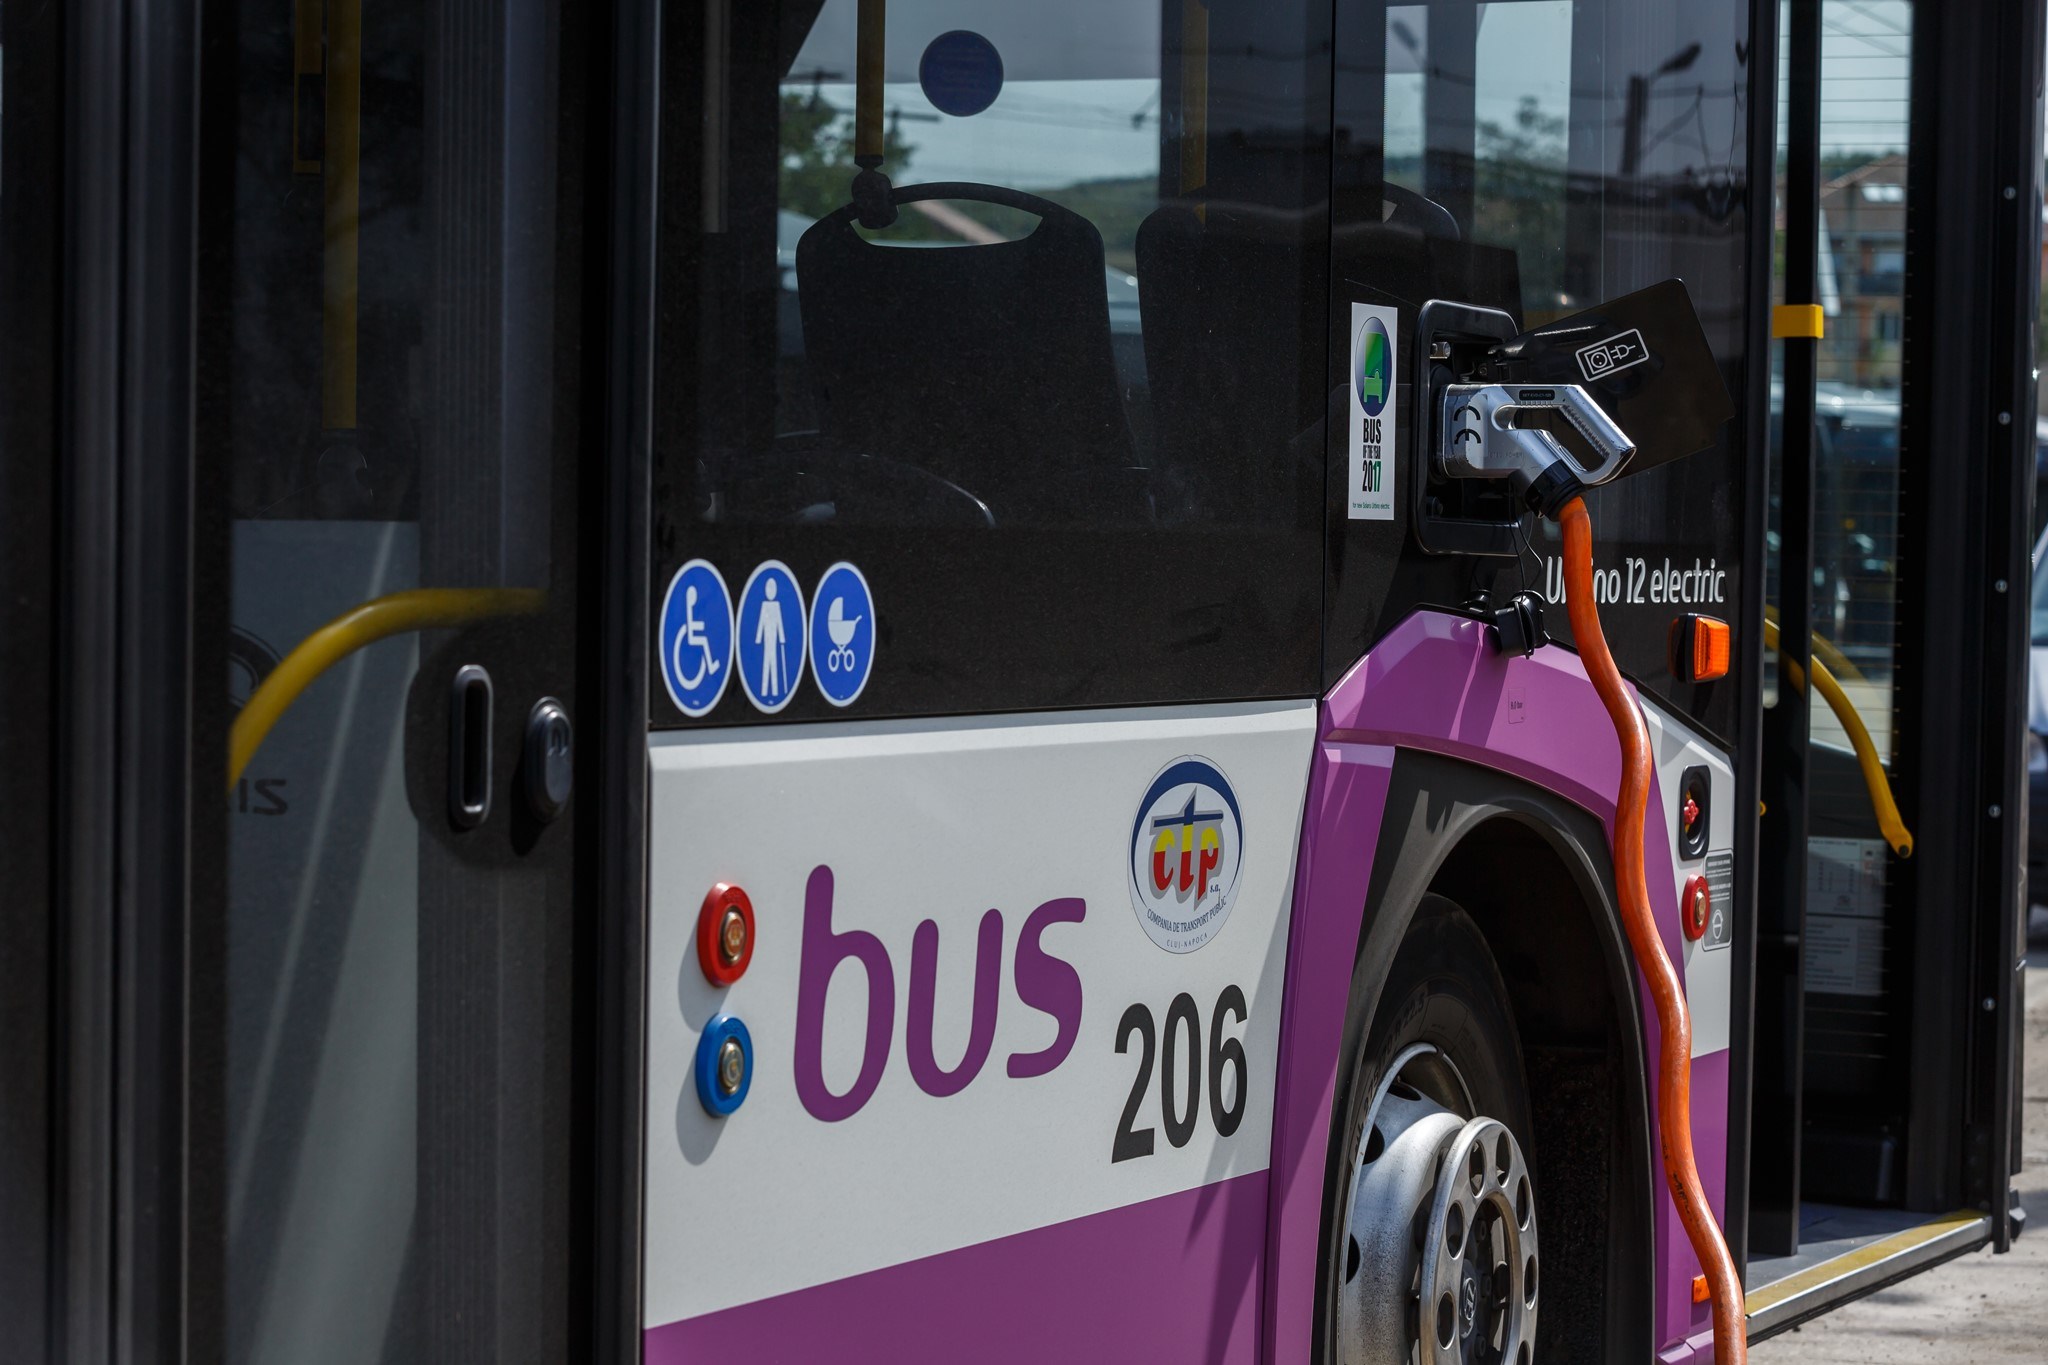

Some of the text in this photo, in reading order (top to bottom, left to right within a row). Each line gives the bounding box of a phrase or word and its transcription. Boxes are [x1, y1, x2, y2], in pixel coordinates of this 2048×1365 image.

[1363, 418, 1381, 444] BUS
[1362, 460, 1382, 492] 2017
[1546, 556, 1726, 604] Uno 12 electric
[229, 777, 288, 815] IS
[1147, 895, 1227, 933] COMPANIA DE TRANSPORT PUBLIC
[1166, 932, 1208, 949] CLUJ-NAPOCA
[794, 864, 1087, 1123] bus
[1111, 984, 1248, 1164] 206
